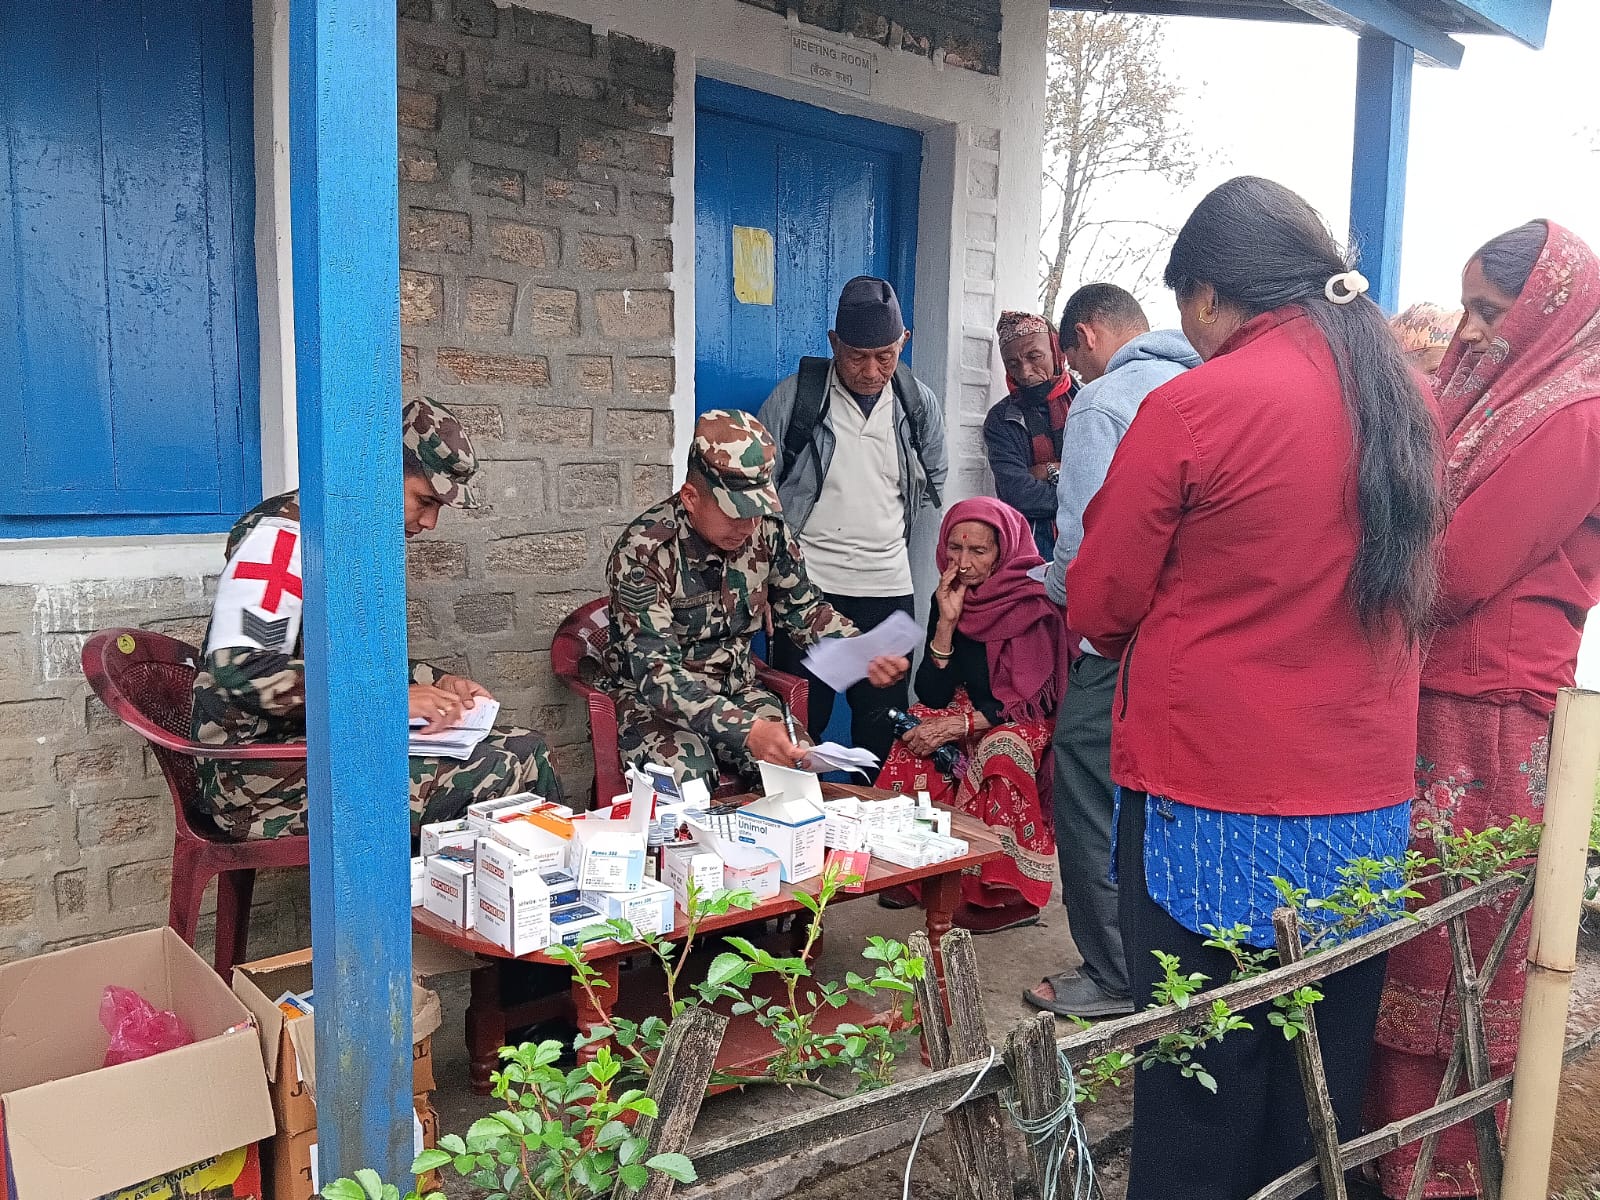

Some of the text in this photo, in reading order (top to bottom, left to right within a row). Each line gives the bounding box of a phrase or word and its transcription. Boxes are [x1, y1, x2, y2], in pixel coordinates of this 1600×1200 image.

[793, 38, 870, 69] MEETING ROOM
[739, 820, 768, 835] Unimol
[170, 1156, 216, 1183] WAFER
